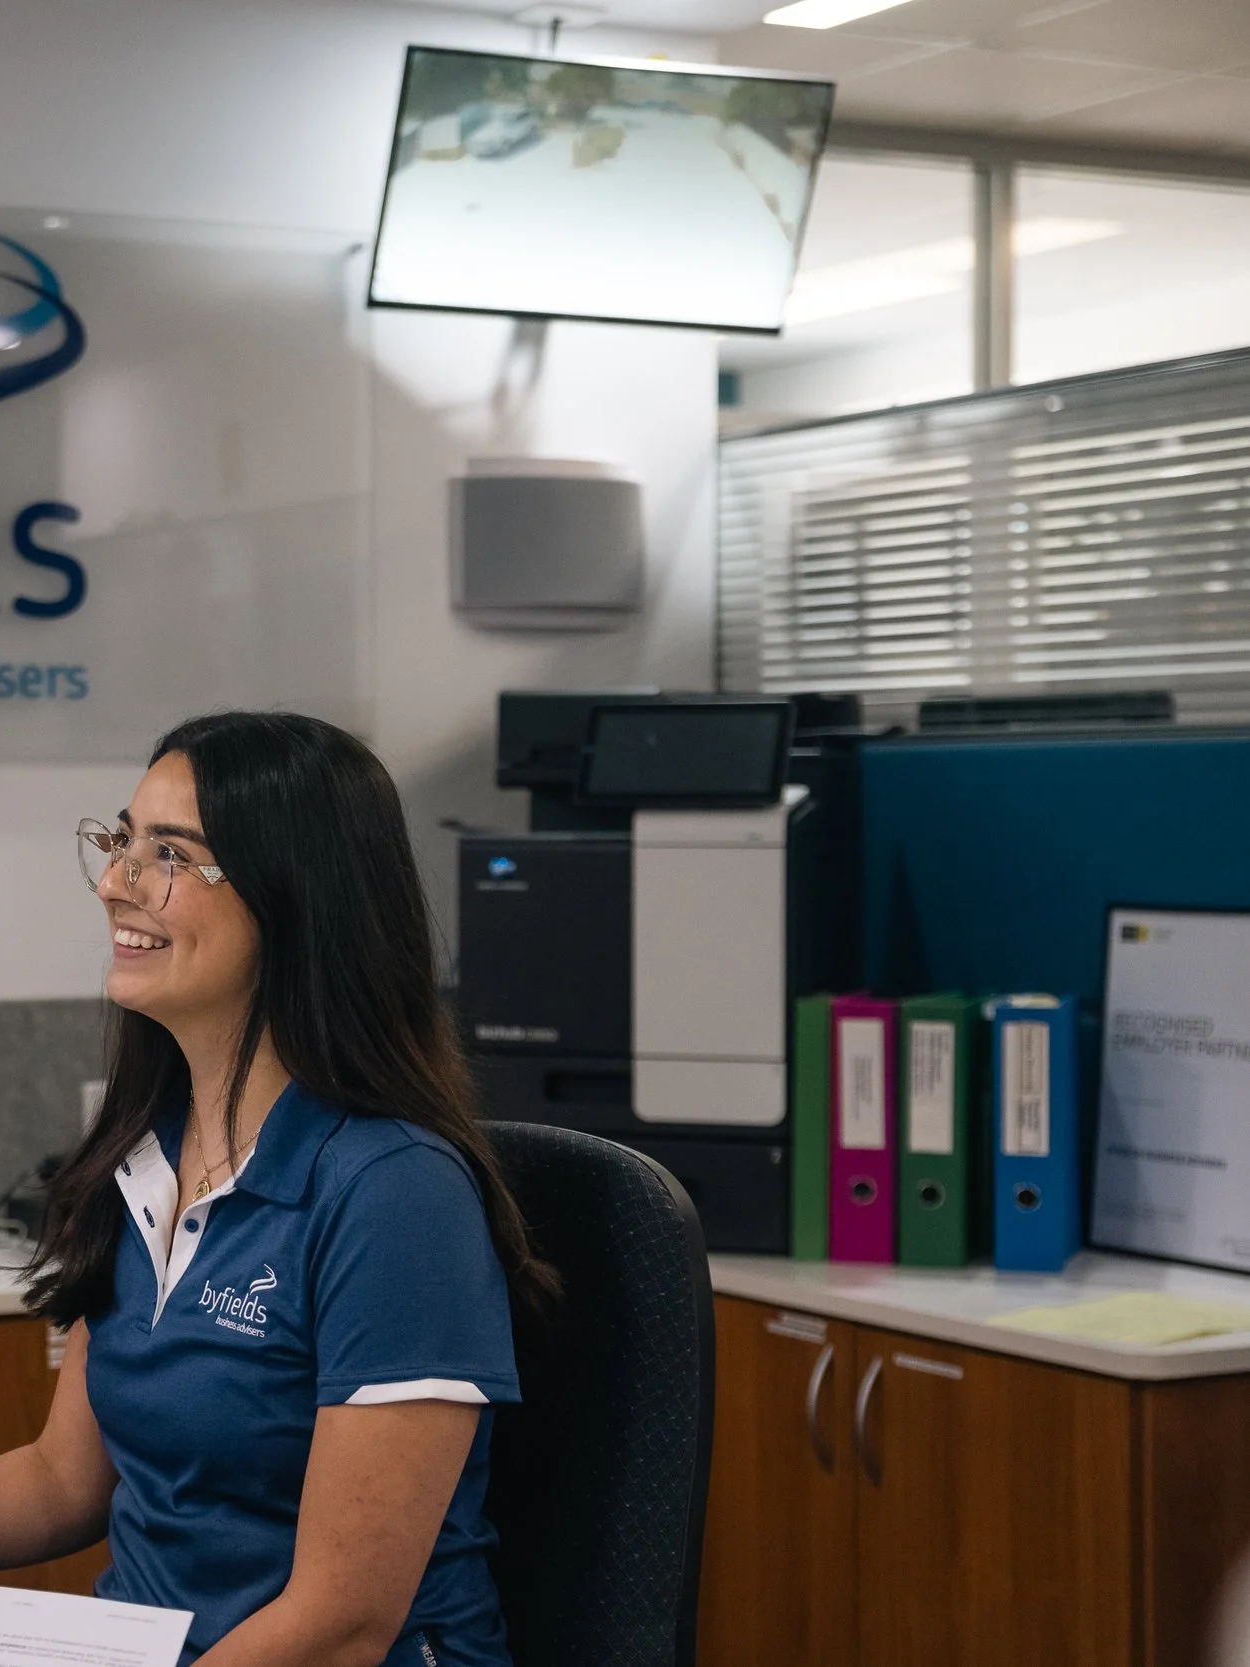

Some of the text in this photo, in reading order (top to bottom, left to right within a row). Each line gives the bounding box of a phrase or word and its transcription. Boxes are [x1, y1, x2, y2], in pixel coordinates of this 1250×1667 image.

[198, 1280, 267, 1324] byfields
[215, 1314, 265, 1338] business advisers
